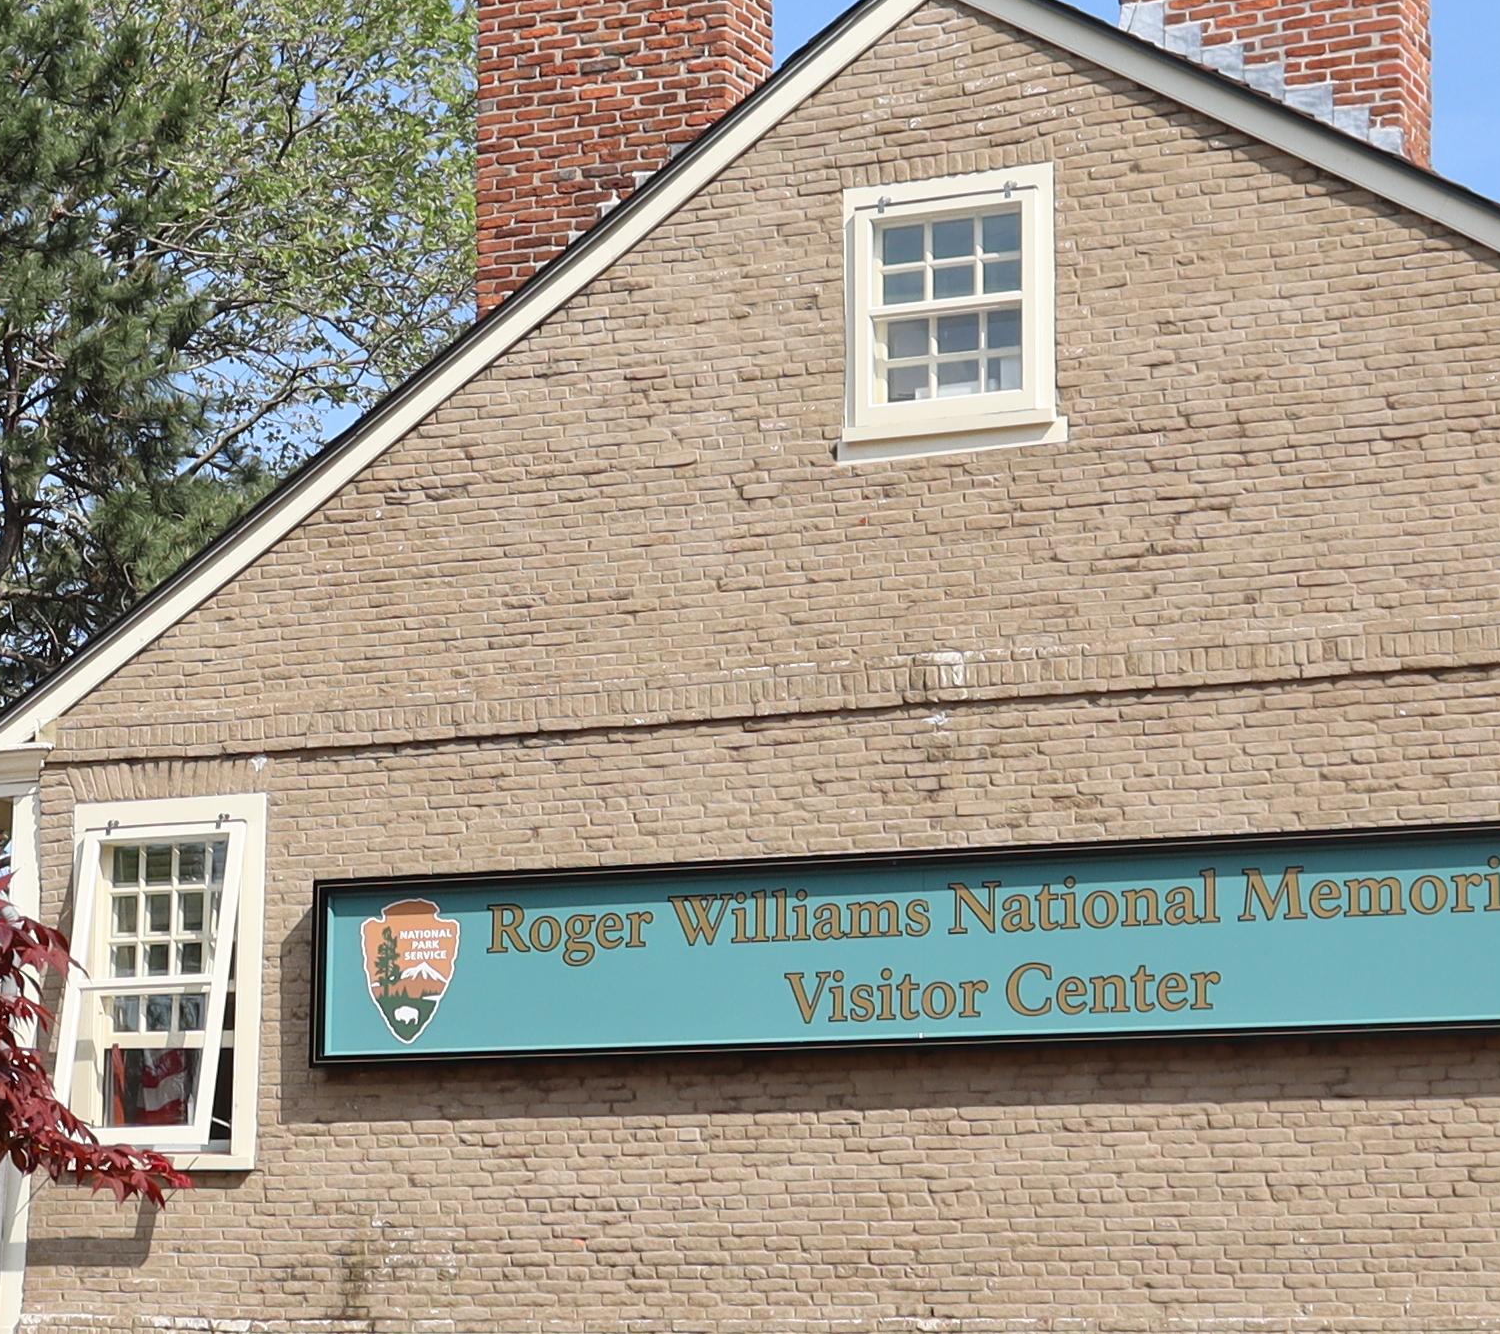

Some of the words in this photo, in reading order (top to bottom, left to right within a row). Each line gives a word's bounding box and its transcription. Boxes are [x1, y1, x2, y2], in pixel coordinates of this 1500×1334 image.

[486, 903, 654, 967] Roger
[667, 888, 931, 946] Williams
[948, 867, 1221, 935] National
[399, 928, 452, 940] NATIONAL
[411, 939, 440, 950] PARK
[404, 950, 447, 961] SERVICE
[784, 968, 989, 1024] Visitor
[1005, 962, 1222, 1016] Center
